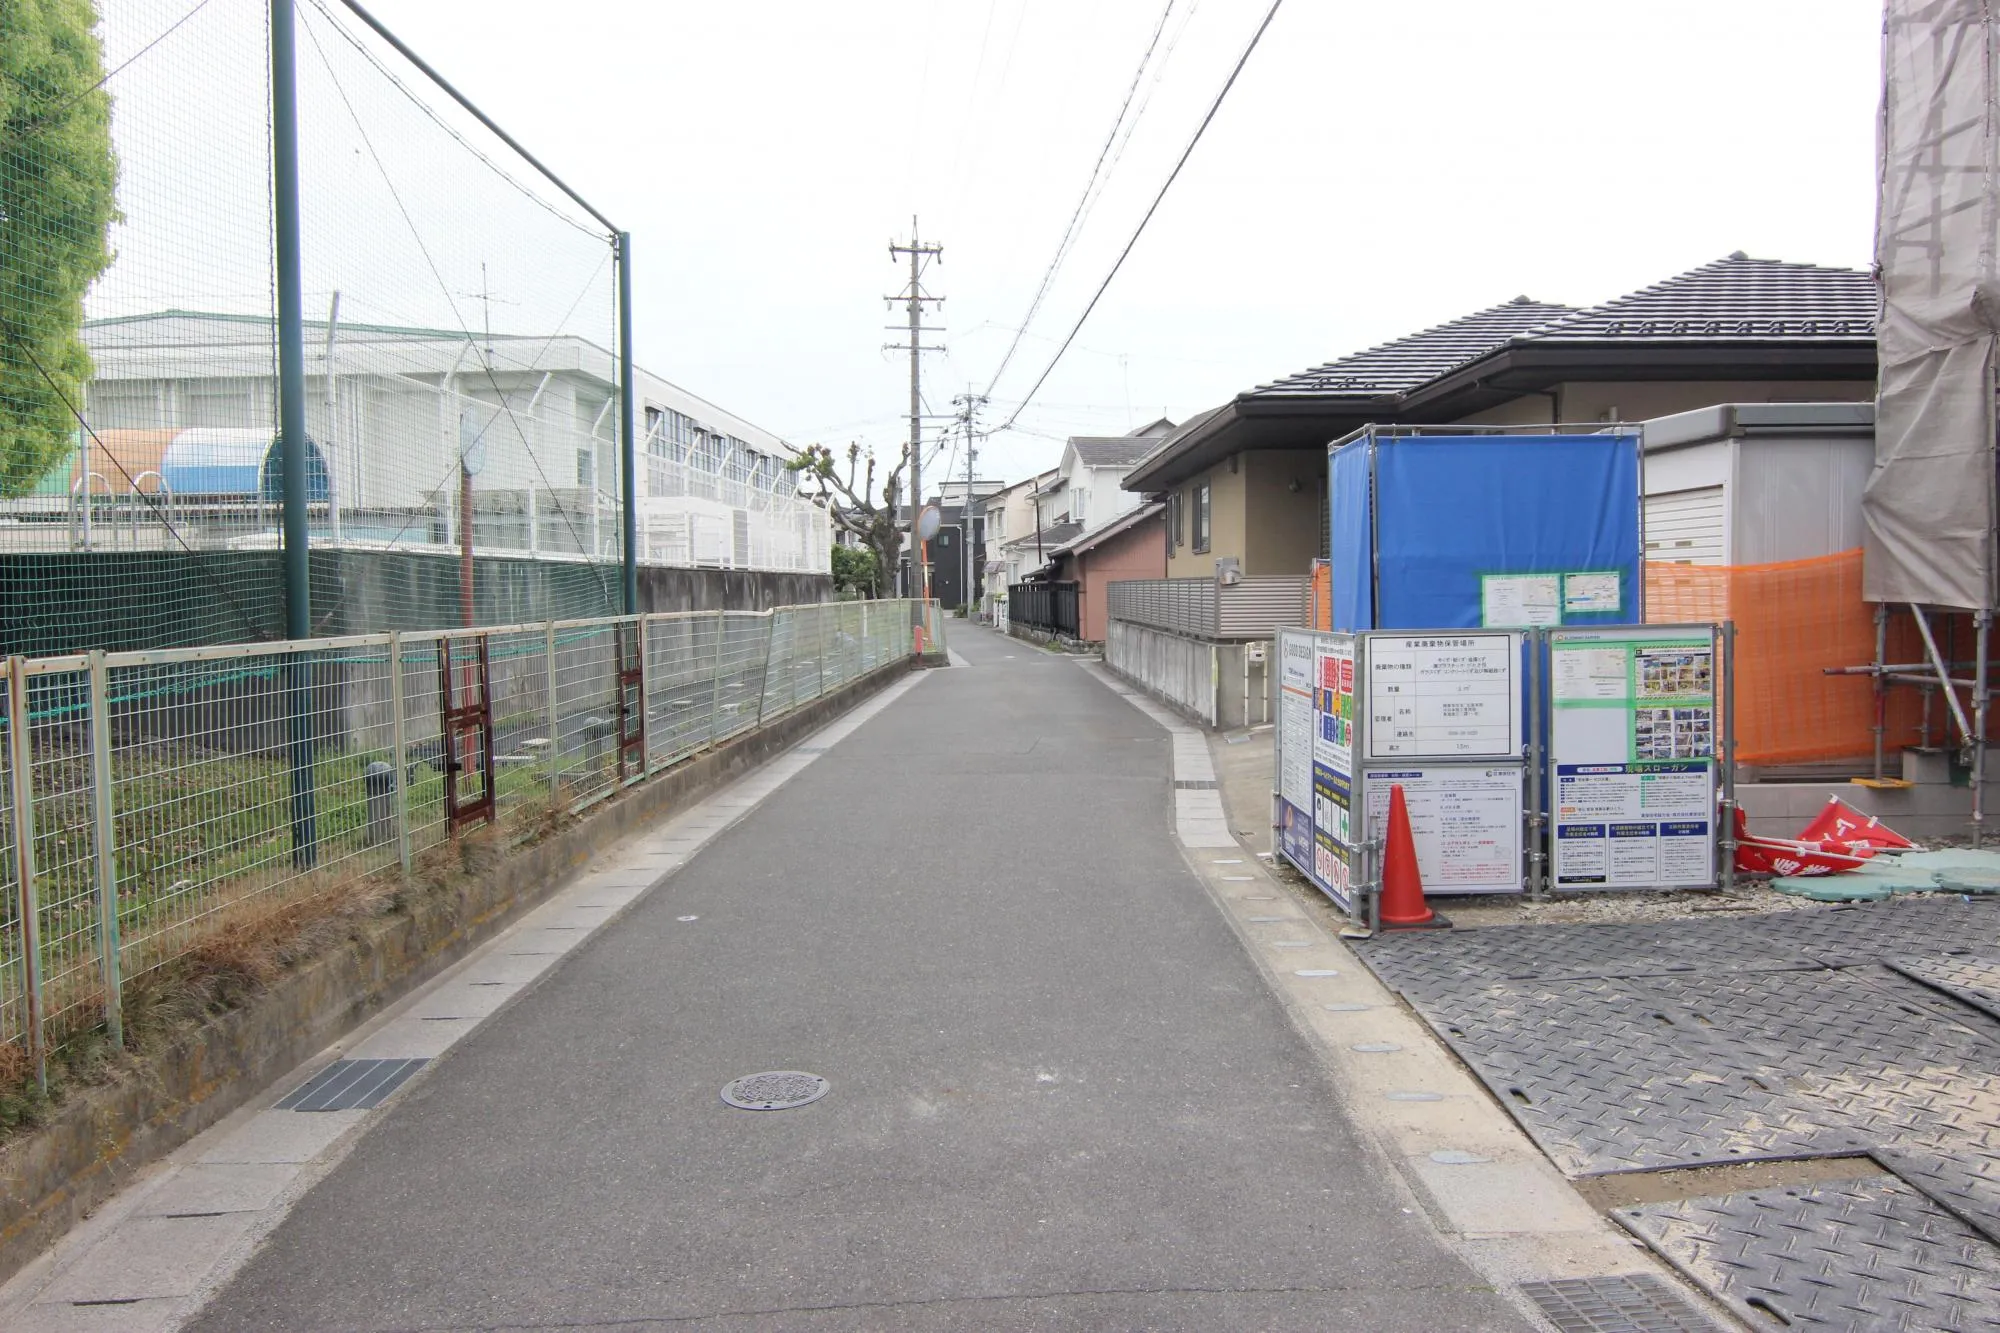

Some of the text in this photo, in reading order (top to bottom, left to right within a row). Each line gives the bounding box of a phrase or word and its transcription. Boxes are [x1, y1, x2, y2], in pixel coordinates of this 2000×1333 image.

[1405, 640, 1475, 648] 産業廃棄物保管場所
